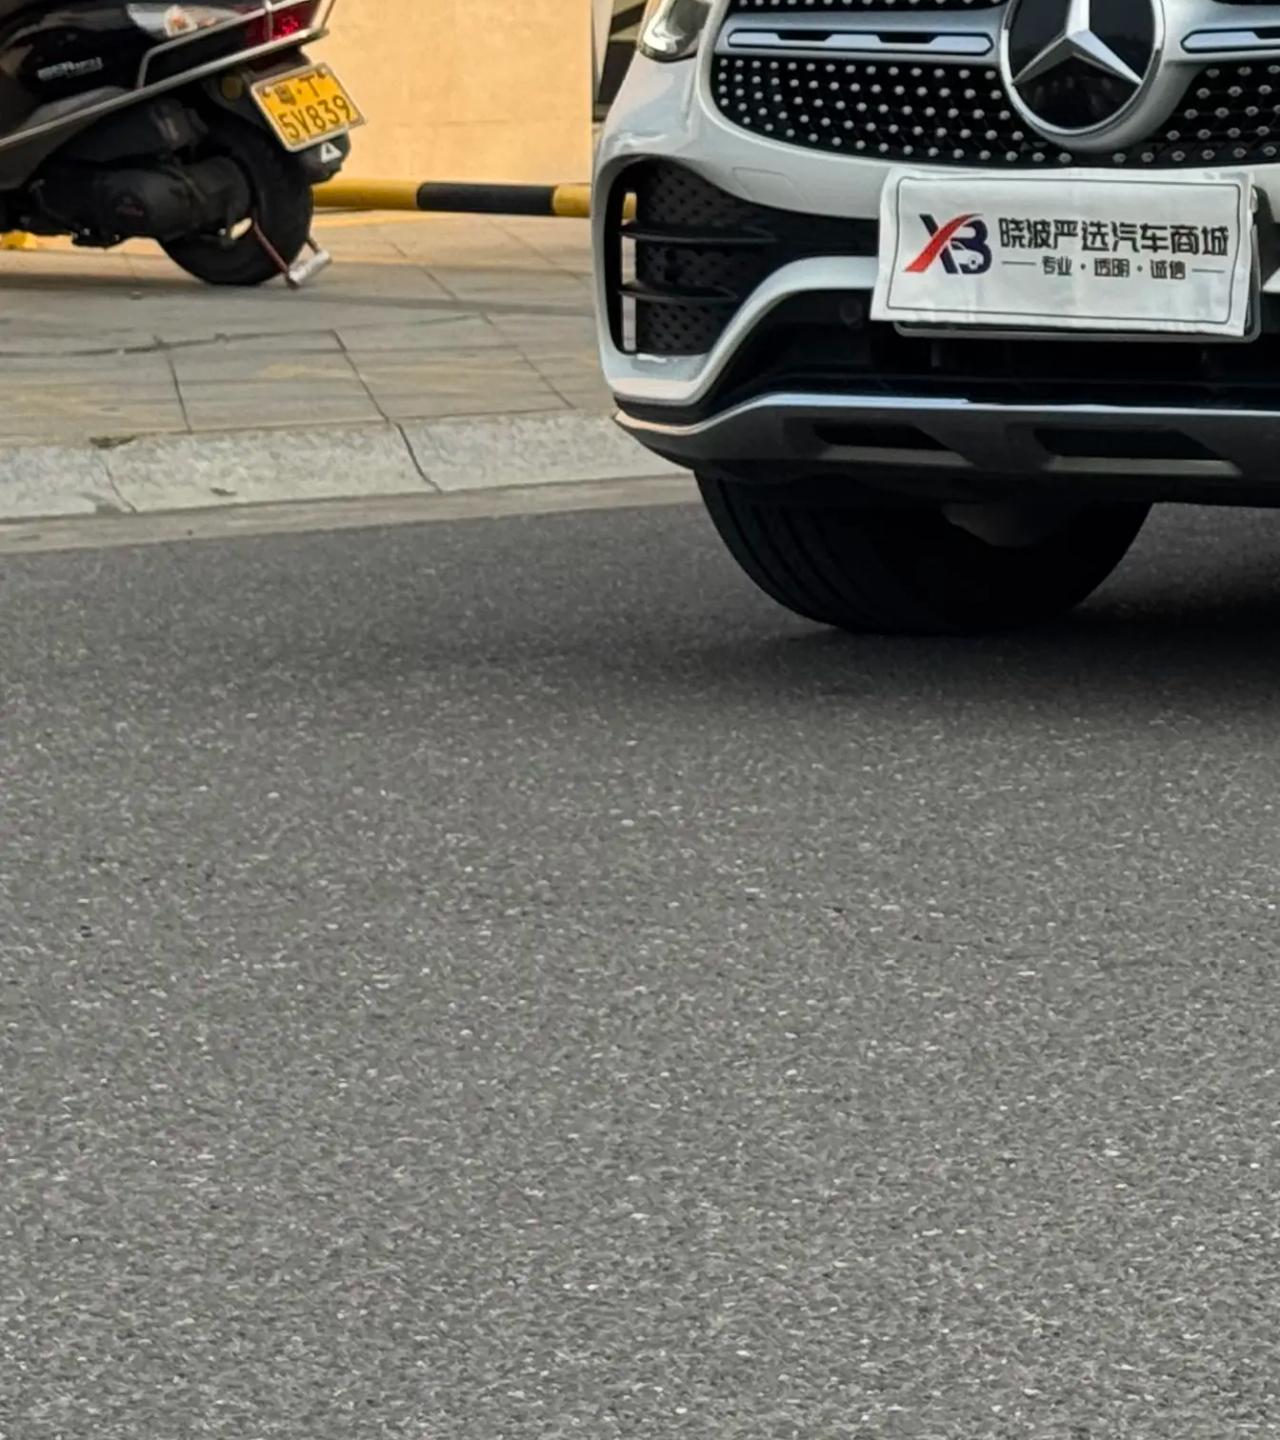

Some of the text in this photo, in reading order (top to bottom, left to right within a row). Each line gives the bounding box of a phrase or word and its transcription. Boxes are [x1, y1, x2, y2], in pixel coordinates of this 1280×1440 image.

[278, 95, 351, 140] 5V839
[999, 217, 1230, 257] 晓波严选汽车商城
